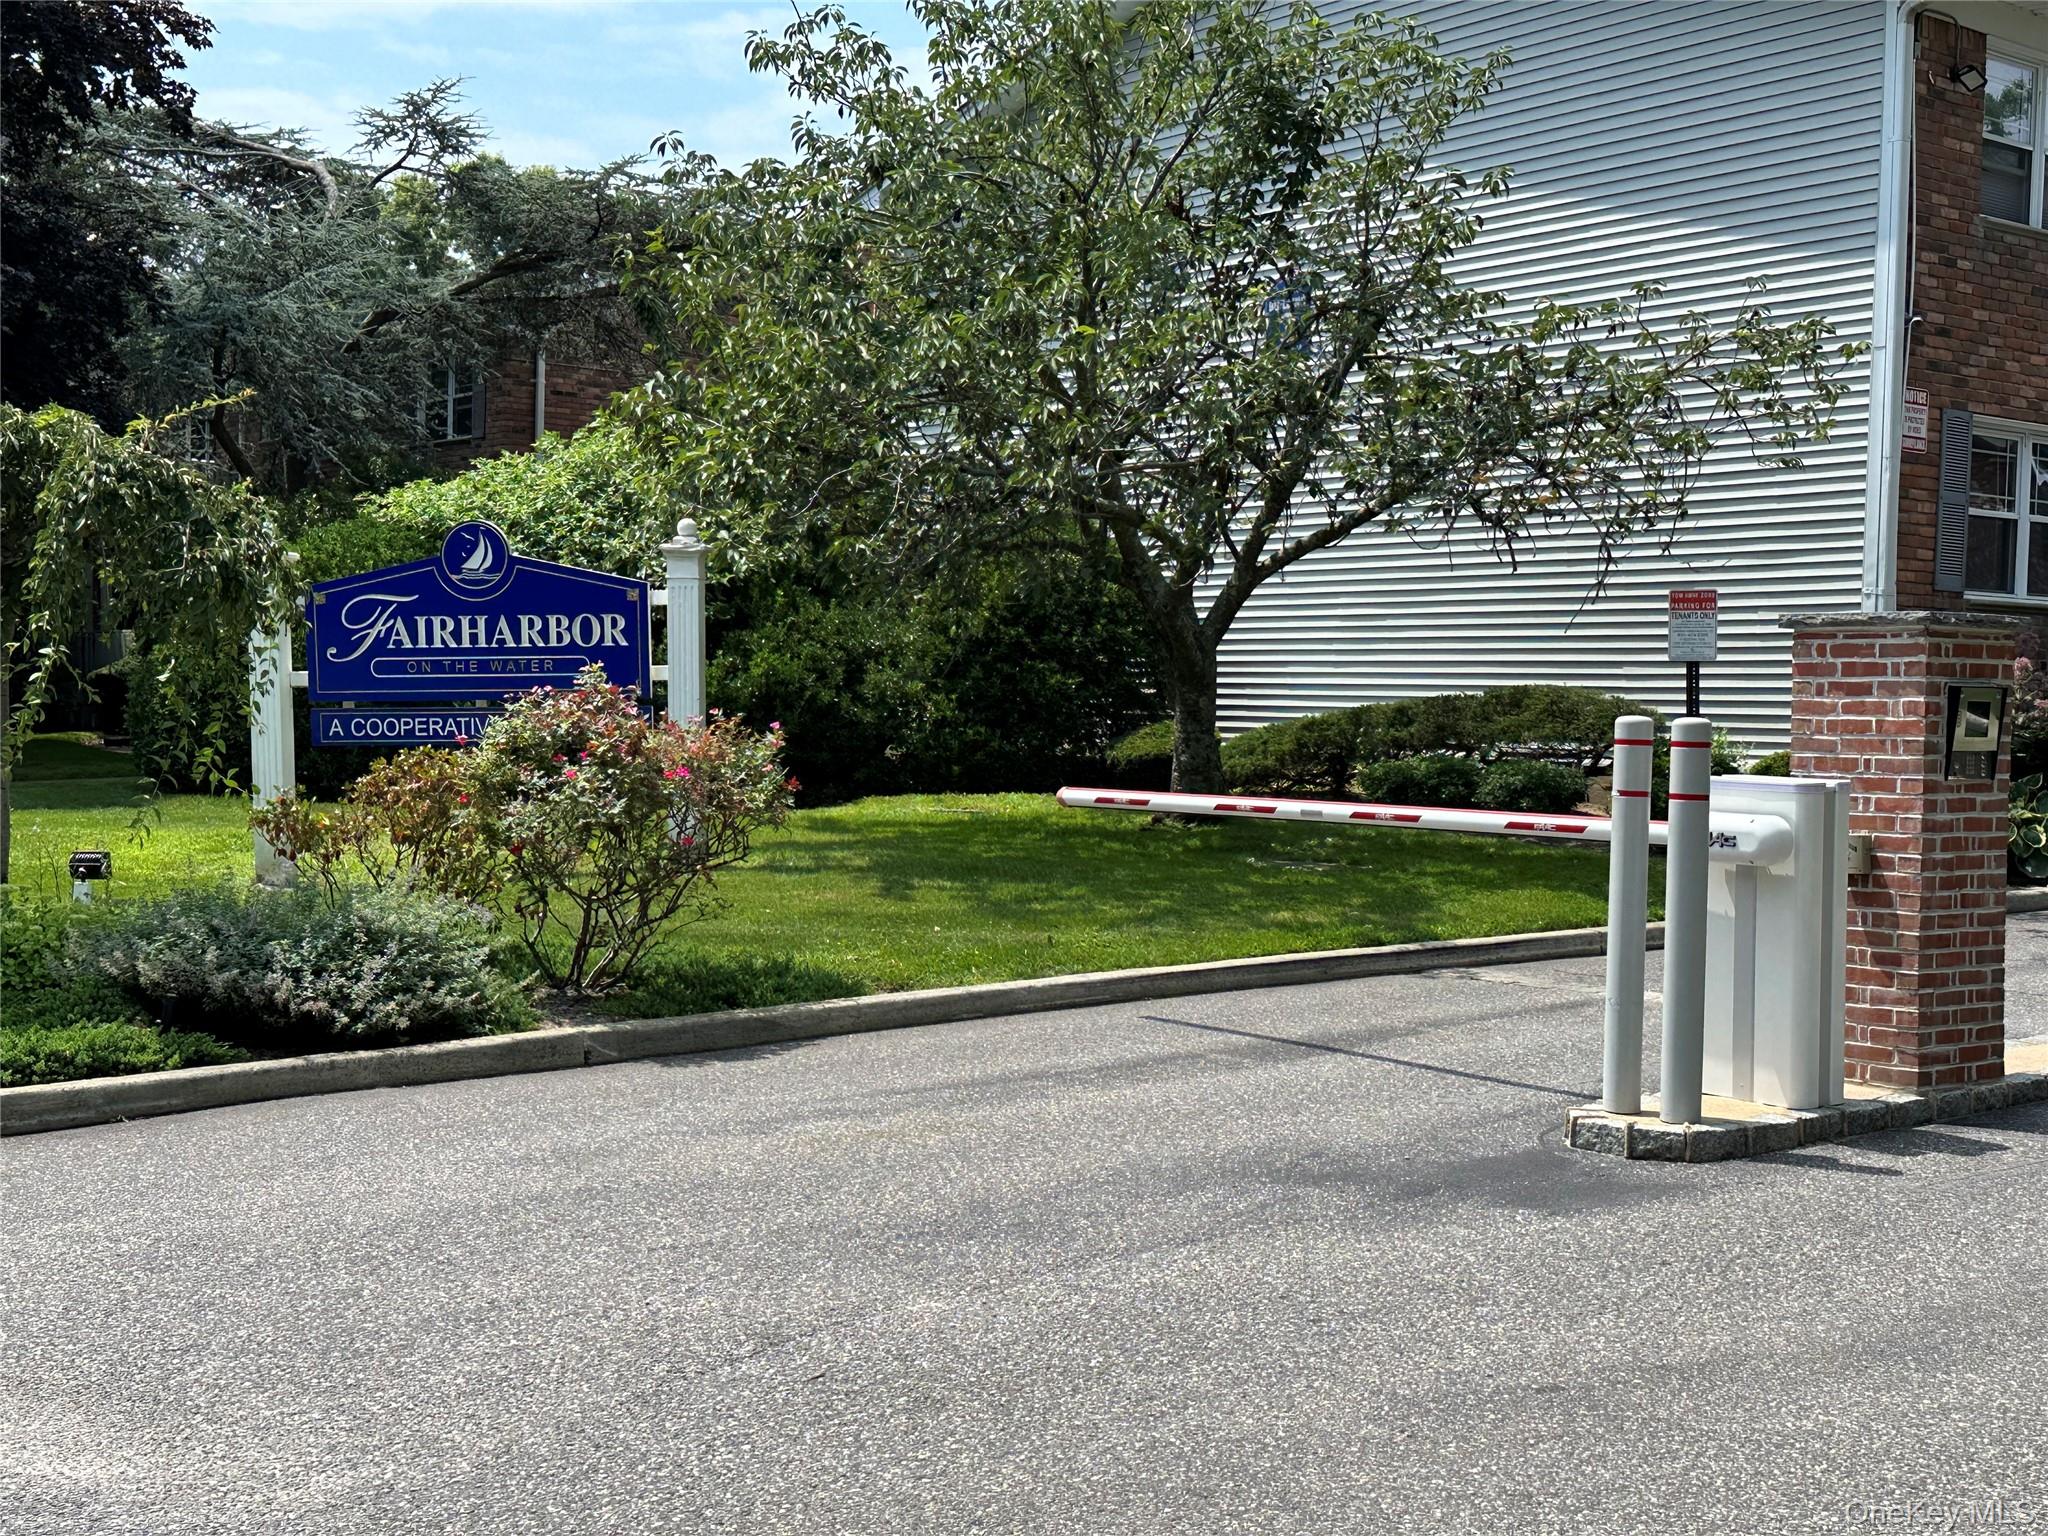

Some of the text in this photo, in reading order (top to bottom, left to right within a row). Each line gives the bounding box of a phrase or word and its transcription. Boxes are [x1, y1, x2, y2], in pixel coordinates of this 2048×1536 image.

[1904, 389, 1928, 405] NOTICE
[1671, 611, 1715, 619] TENANTS ONLY
[326, 594, 629, 662] FAIRHARBOR
[407, 660, 553, 673] ON THE WATER
[329, 717, 489, 737] A COOPERATIV
